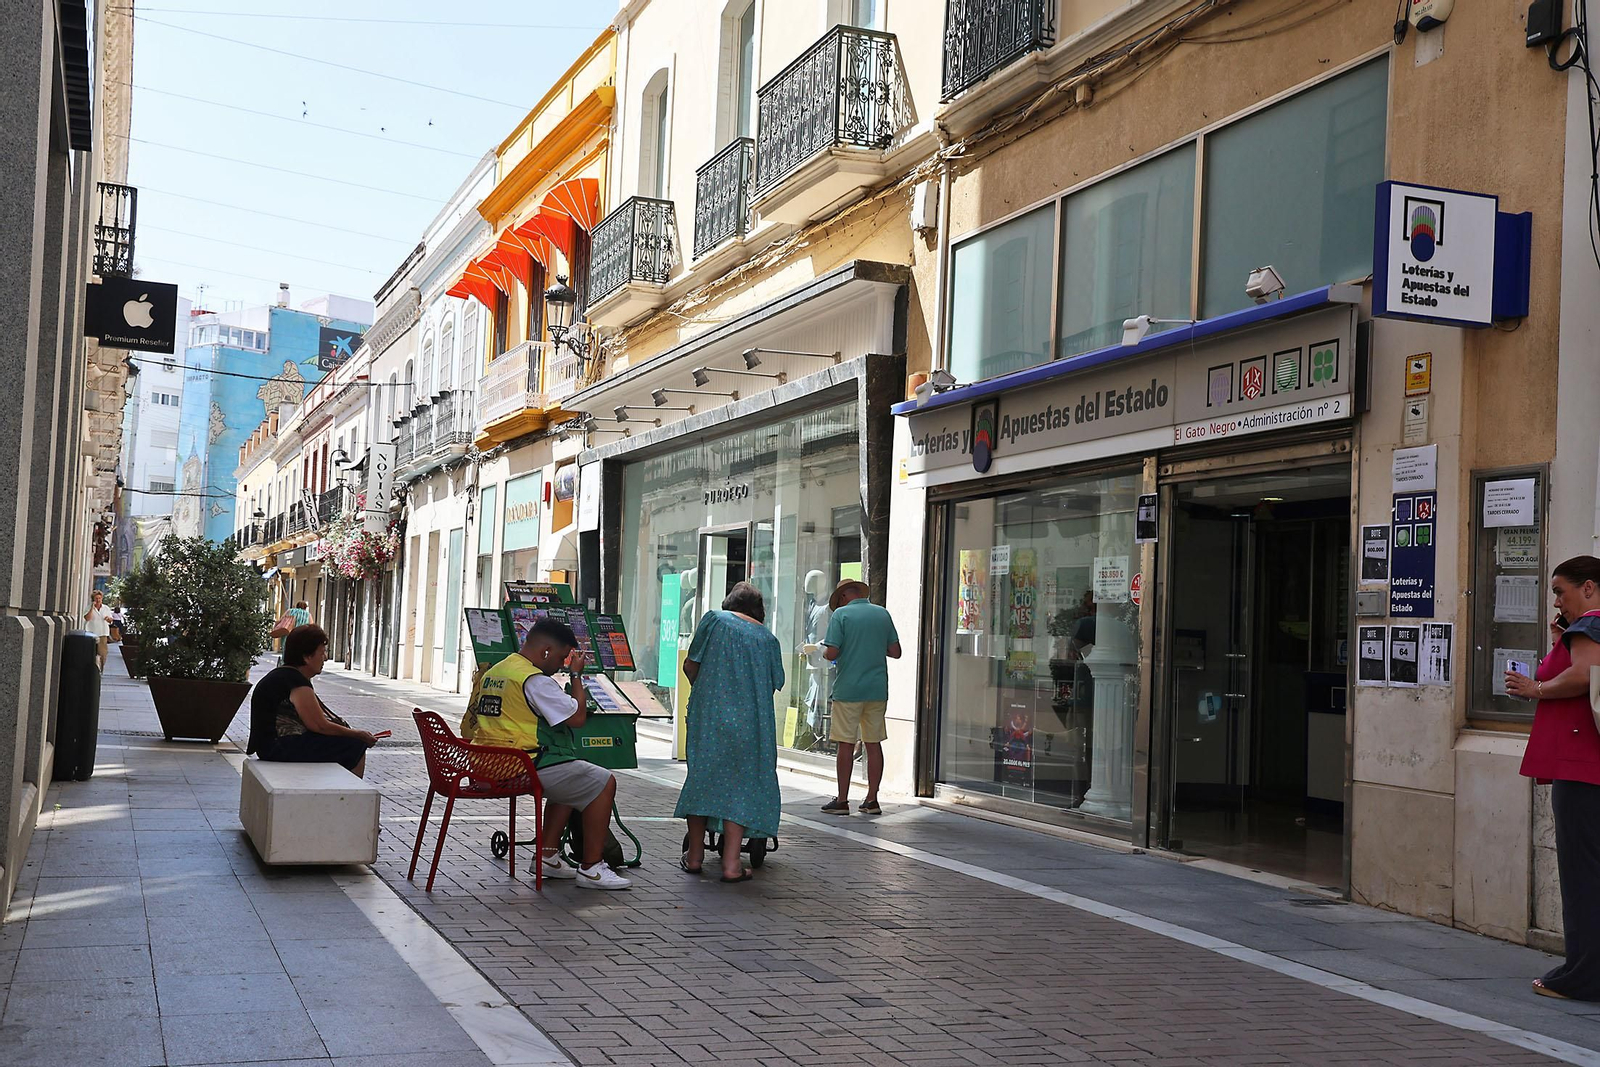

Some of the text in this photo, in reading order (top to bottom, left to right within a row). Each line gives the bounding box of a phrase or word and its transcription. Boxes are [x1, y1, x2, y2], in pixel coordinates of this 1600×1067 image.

[1402, 262, 1454, 283] Loterías y
[1402, 278, 1470, 297] Apuestas del
[1401, 292, 1438, 307] Estado
[104, 334, 138, 344] Premium
[911, 379, 1169, 457] Loterías y Apuestas del Estado
[1175, 429, 1181, 440] El
[1186, 426, 1206, 438] Gato
[1210, 421, 1236, 435] Negro
[1243, 406, 1313, 429] Administración
[1334, 400, 1340, 413] 2
[373, 453, 388, 509] NOVIAS
[302, 488, 318, 531] FUSION
[1370, 529, 1382, 537] BOTE
[1507, 536, 1532, 545] 44.199
[1392, 577, 1423, 587] Loterías y
[1391, 590, 1432, 600] Apuestas del
[1391, 603, 1413, 612] Estado
[1399, 630, 1409, 639] BOTE
[1399, 647, 1408, 656] 64
[1431, 645, 1440, 654] 23
